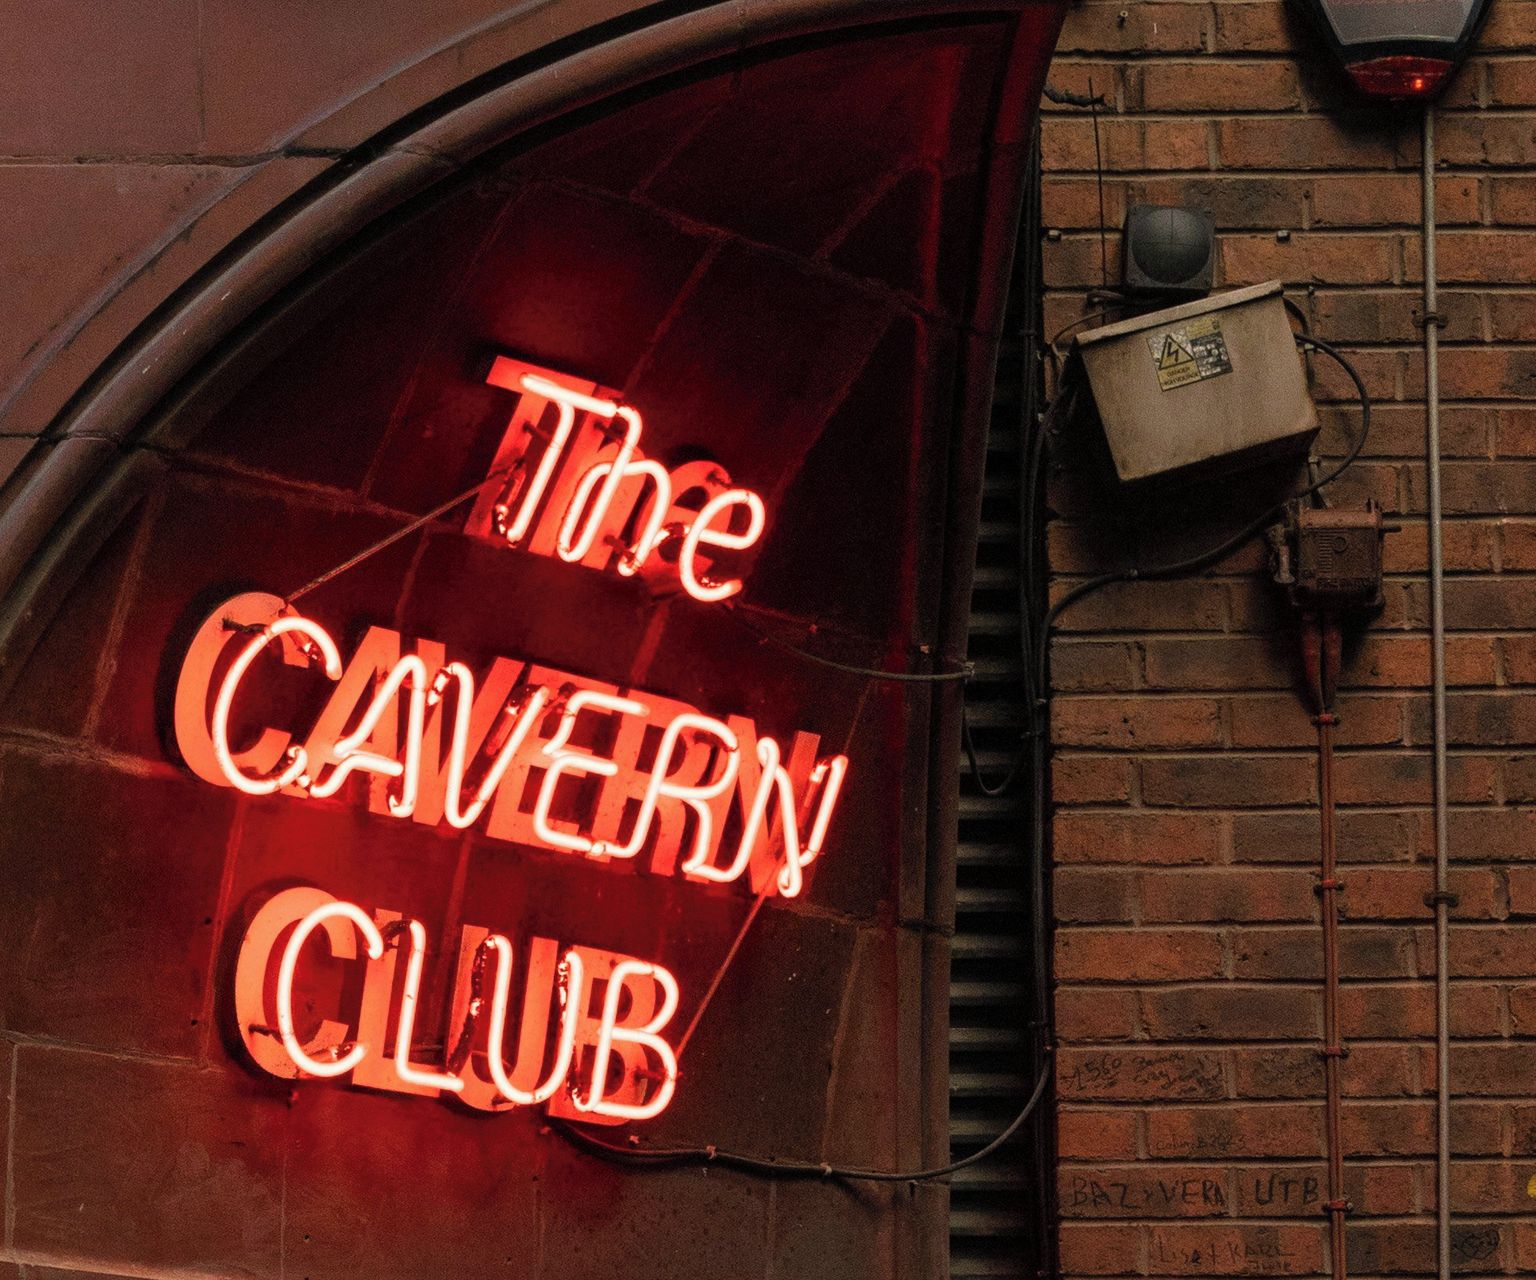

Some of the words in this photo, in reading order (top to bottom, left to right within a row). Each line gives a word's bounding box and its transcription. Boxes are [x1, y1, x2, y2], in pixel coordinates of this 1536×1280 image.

[467, 356, 765, 601] The
[175, 591, 847, 897] CAVERN
[234, 886, 680, 1125] CLUB
